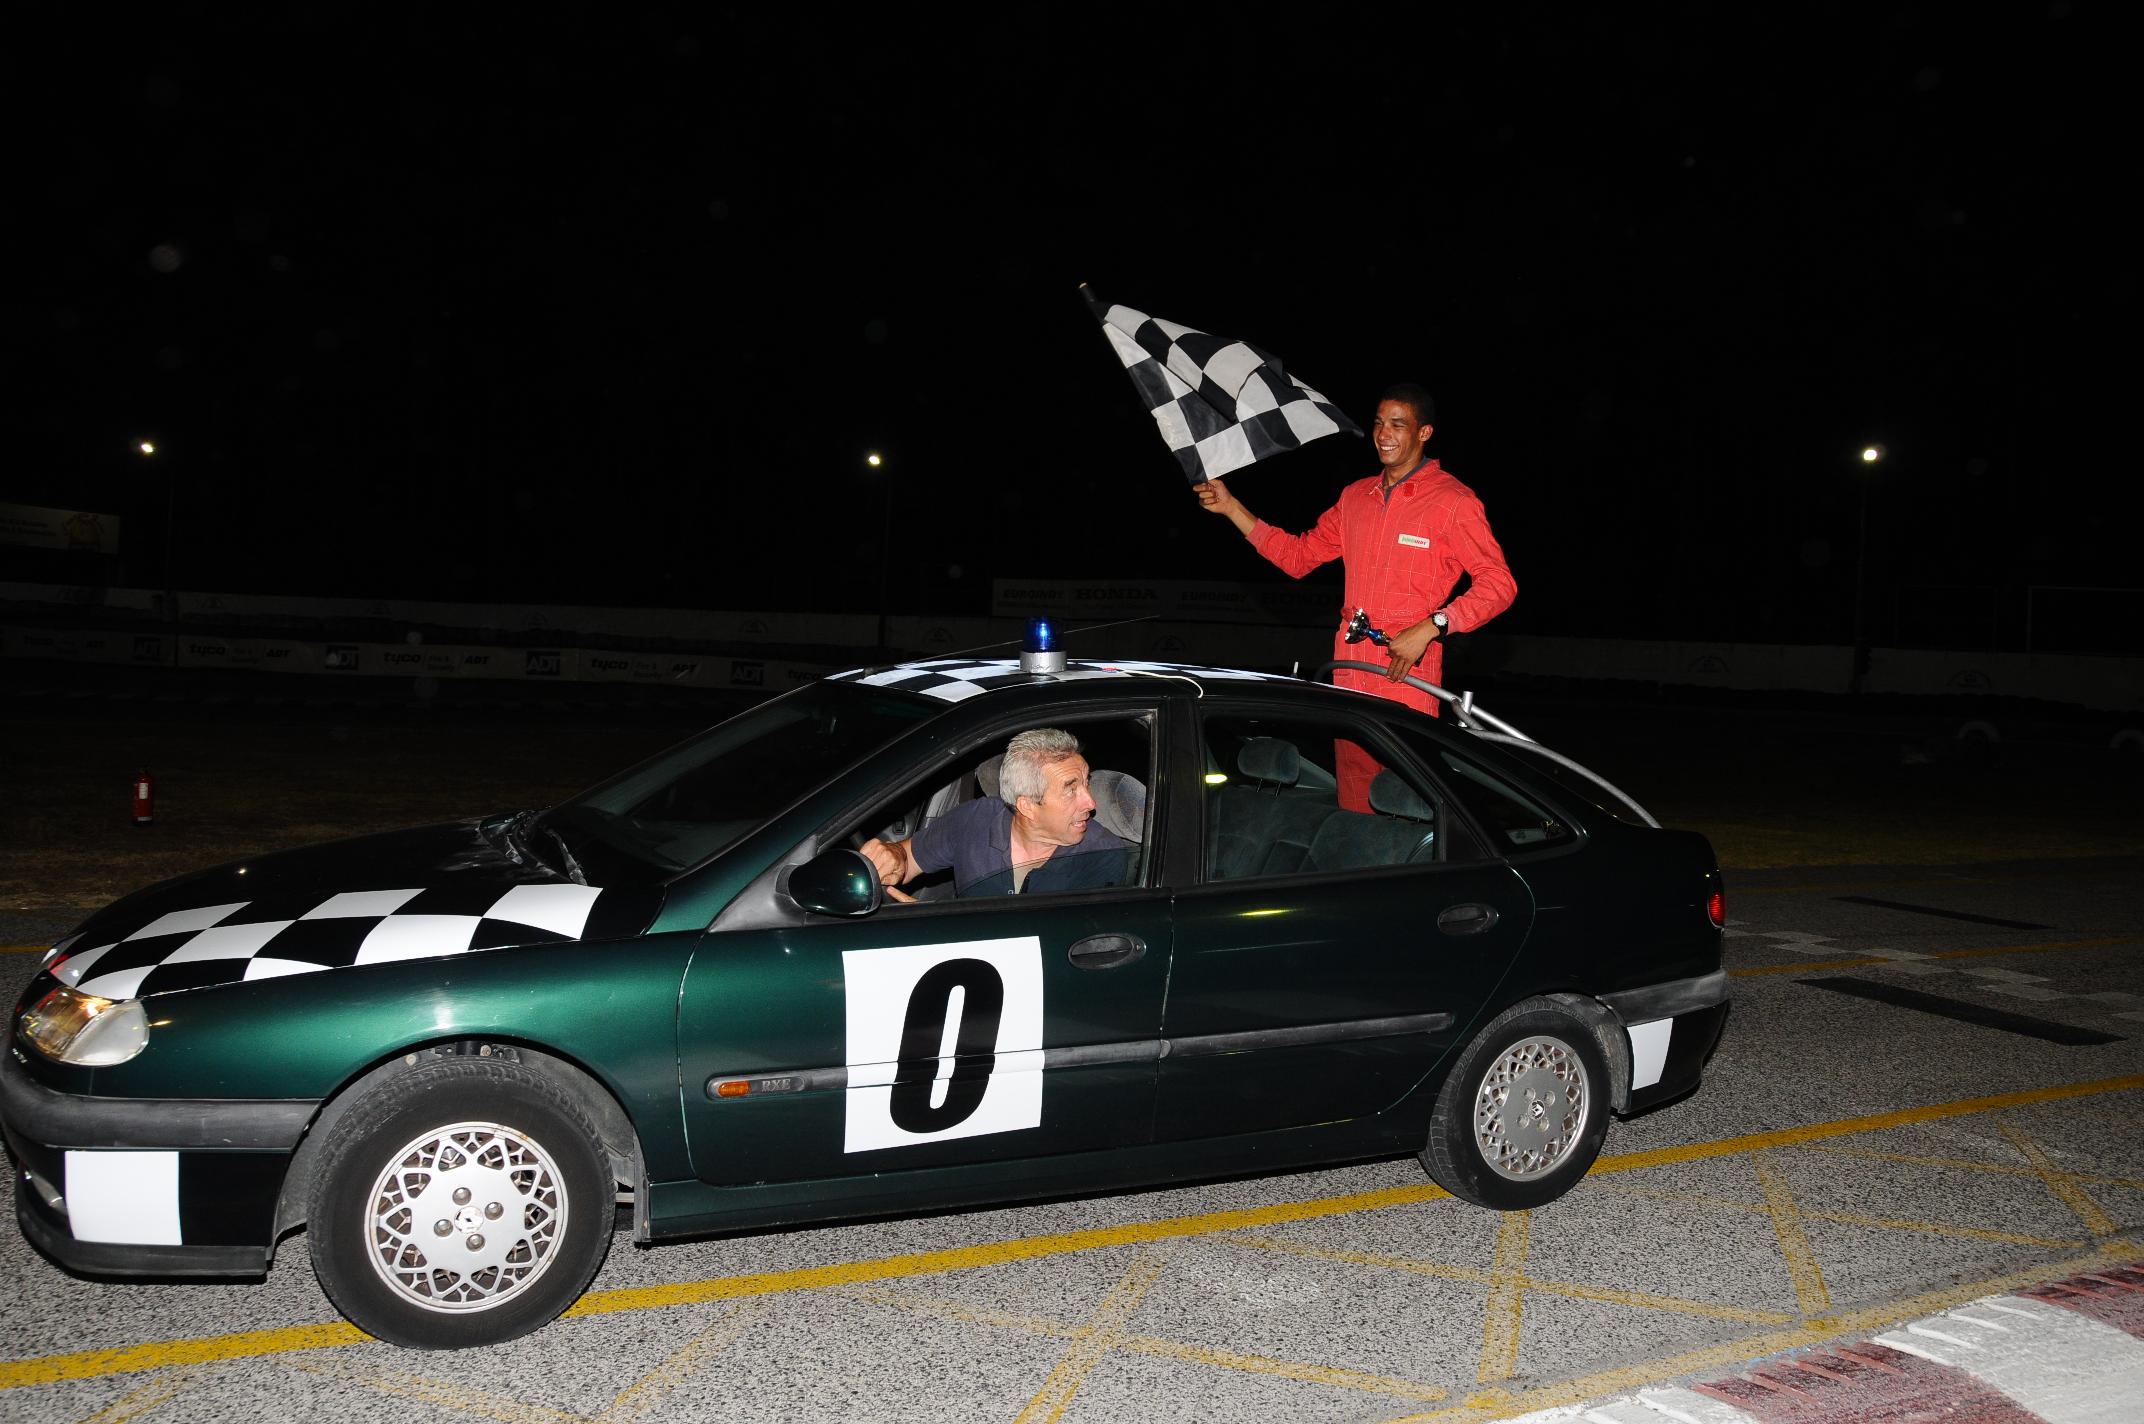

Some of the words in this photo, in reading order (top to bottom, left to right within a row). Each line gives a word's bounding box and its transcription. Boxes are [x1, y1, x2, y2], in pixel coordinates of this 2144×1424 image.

[1075, 588, 1158, 600] HONDA
[190, 643, 226, 656] tyco
[384, 652, 420, 664] tyco
[464, 656, 489, 664] ADT
[528, 655, 561, 673] ADT
[591, 659, 628, 670] tyco
[732, 665, 762, 682] ADT
[890, 958, 1004, 1133] 0
